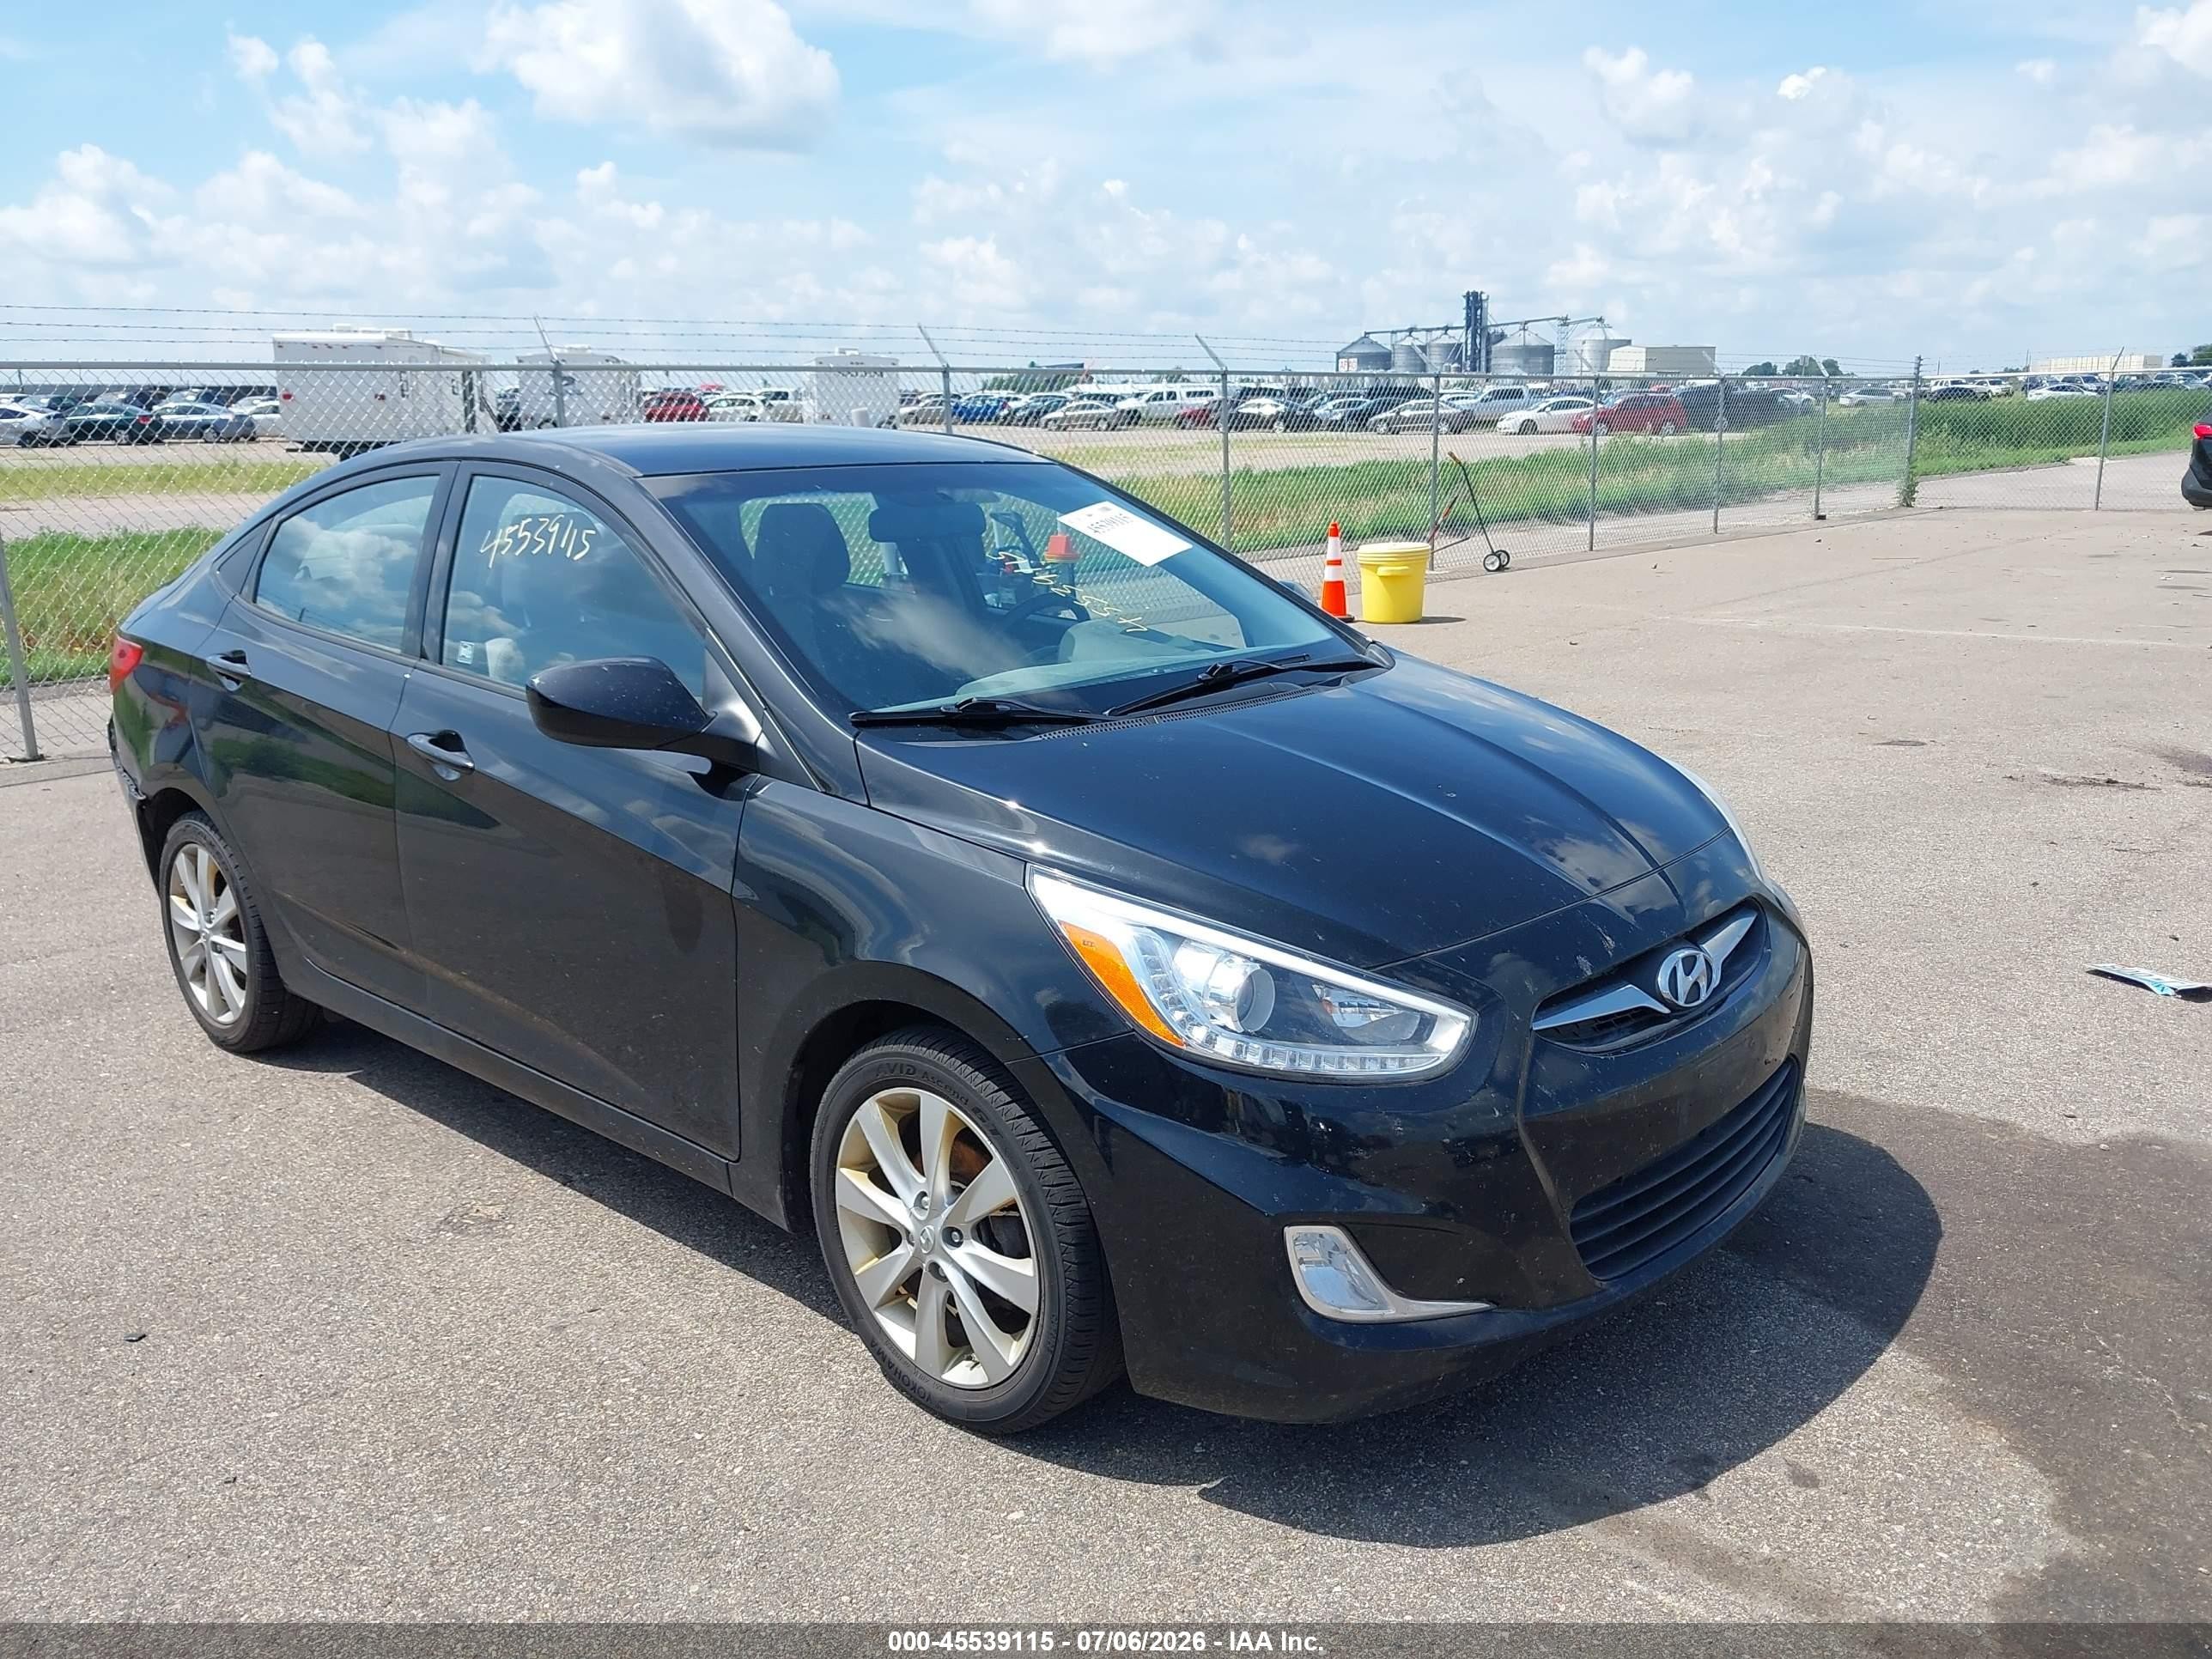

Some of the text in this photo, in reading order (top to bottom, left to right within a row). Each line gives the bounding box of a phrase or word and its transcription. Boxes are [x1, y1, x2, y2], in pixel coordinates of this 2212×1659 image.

[479, 514, 596, 568] 45539115
[876, 1062, 917, 1077] AVID
[870, 1340, 933, 1403] YOKOHAMA
